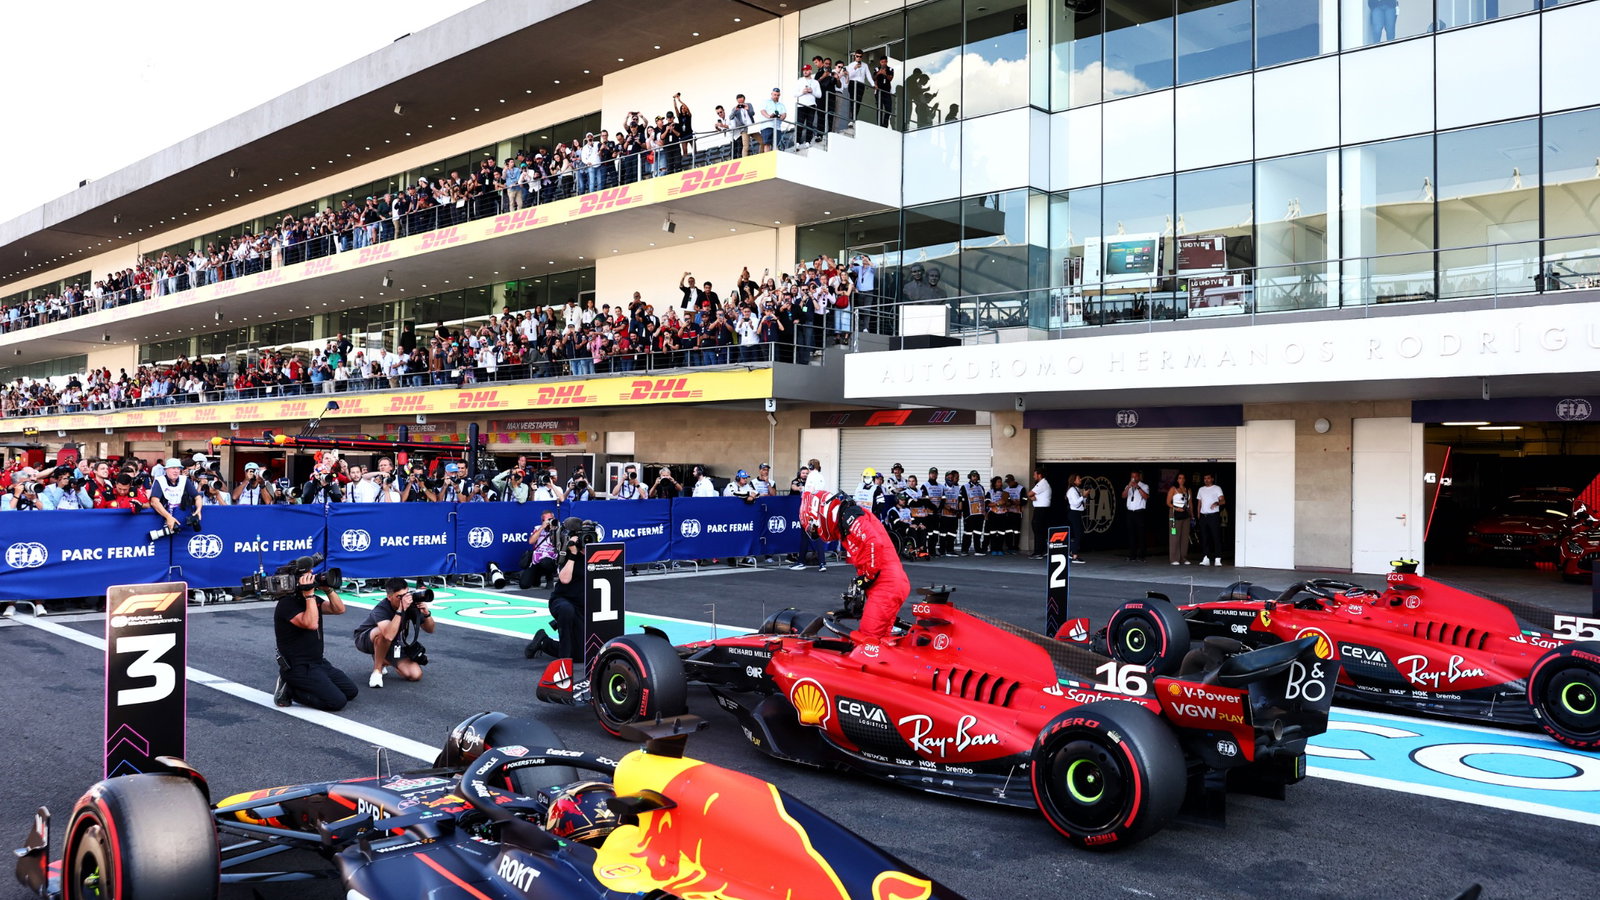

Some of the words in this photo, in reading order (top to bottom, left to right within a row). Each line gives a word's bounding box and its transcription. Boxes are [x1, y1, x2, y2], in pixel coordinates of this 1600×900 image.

[679, 161, 745, 193] DHL
[578, 186, 632, 215] DHL
[493, 208, 538, 234] DHL
[421, 226, 462, 249] DHL
[359, 243, 394, 264] DHL
[304, 257, 334, 276] DHL
[881, 354, 1084, 384] AUTÓDROMO
[1108, 341, 1336, 373] HERMANOS
[537, 385, 588, 405] DHL
[630, 378, 691, 400] DHL
[280, 401, 308, 416] DHL
[390, 395, 427, 412] DHL
[457, 390, 500, 409] DHL
[768, 400, 773, 408] 3
[1017, 398, 1024, 407] 2
[195, 408, 217, 421] DHL
[235, 406, 258, 419] DHL
[1558, 402, 1589, 417] FIA
[1117, 413, 1137, 425] FIA
[407, 425, 421, 433] ERGIO
[612, 528, 636, 539] PARC
[637, 523, 664, 536] FERMÉ
[682, 522, 700, 534] FIA
[707, 523, 728, 533] PARC
[729, 519, 753, 532] FERMÉ
[189, 537, 219, 555] FIA
[234, 540, 269, 553] PARC
[272, 536, 313, 551] FERMÉ
[343, 533, 368, 547] FIA
[380, 535, 410, 547] PARC
[412, 532, 447, 546] FERMÉ
[470, 530, 492, 542] FIA
[501, 532, 528, 543] PARC
[8, 546, 44, 565] FIA
[61, 547, 103, 561] PARC
[106, 541, 155, 559] FERMÉ
[1050, 553, 1067, 589] 2
[592, 578, 618, 622] 1
[912, 604, 931, 614] ZCG
[1553, 614, 1600, 641] 55
[728, 647, 753, 657] RICHARD
[754, 650, 771, 659] MILLE
[865, 643, 880, 652] aws
[116, 633, 176, 706] 3
[1397, 654, 1484, 688] Ray-Ban
[1093, 661, 1148, 697] 16
[1183, 686, 1240, 704] V-Power
[1171, 702, 1217, 719] VGW
[1218, 713, 1244, 724] PLAY
[859, 719, 888, 730] LOGISTICS
[1051, 717, 1101, 734] ZERO
[898, 714, 1000, 757] Ray-Ban
[546, 748, 584, 757] telcel
[476, 757, 499, 775] ORACLE
[507, 758, 546, 769] POKERSTARS
[918, 760, 937, 769] NGK
[945, 765, 973, 774] brembo
[498, 854, 541, 893] ROKT
